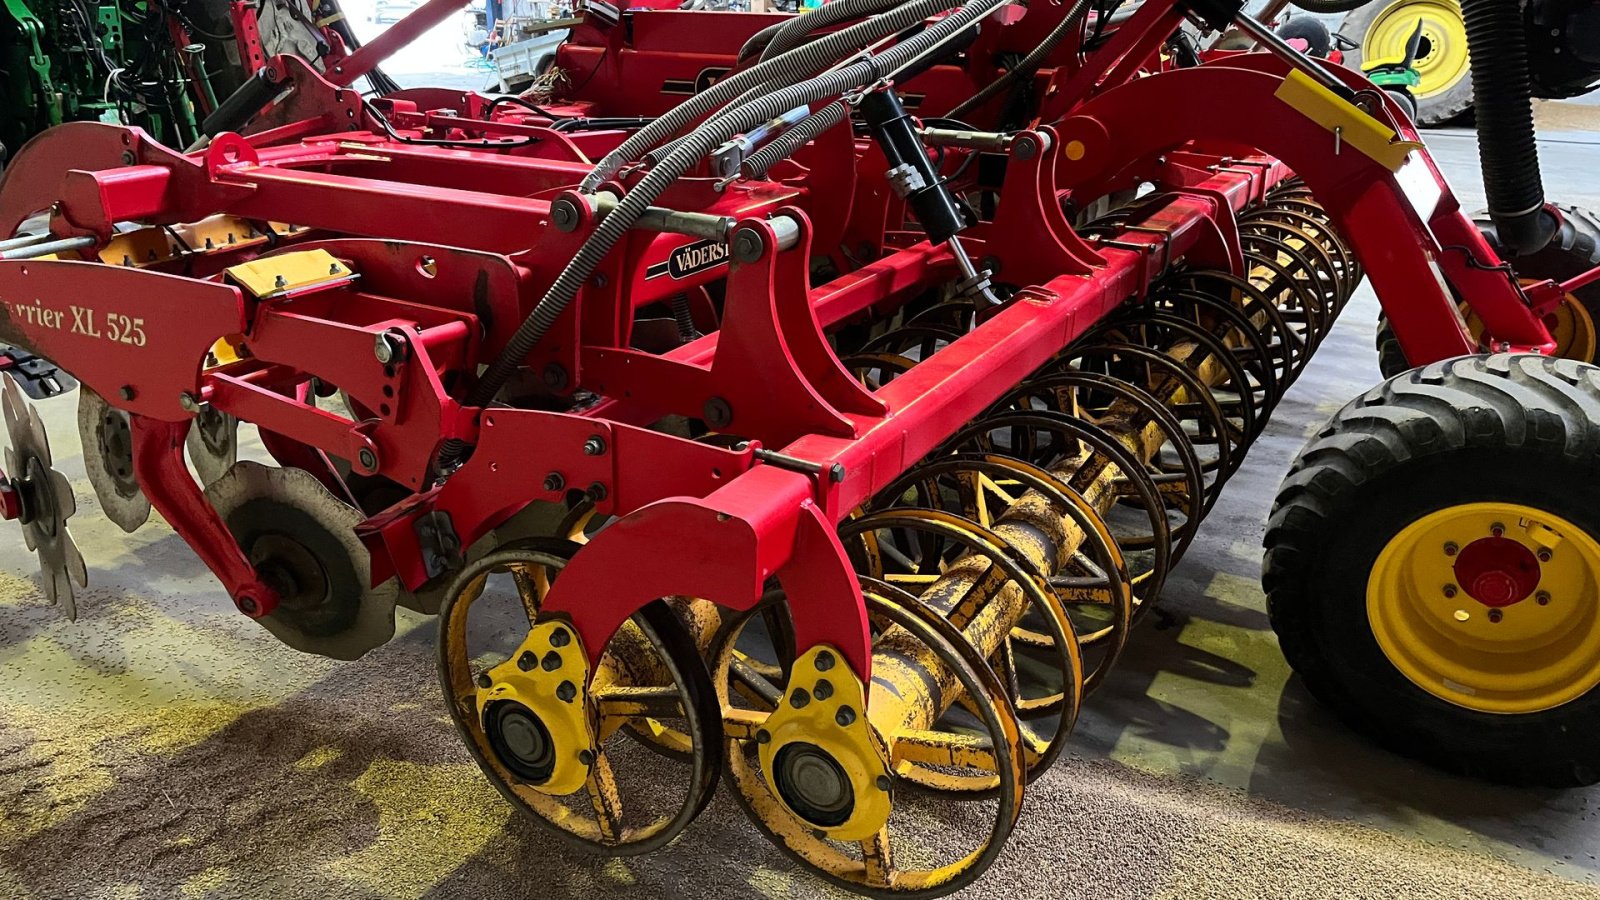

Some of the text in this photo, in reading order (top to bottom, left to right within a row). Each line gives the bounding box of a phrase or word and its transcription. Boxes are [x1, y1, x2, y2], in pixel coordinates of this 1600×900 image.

[5, 298, 146, 346] rrier XL 525
